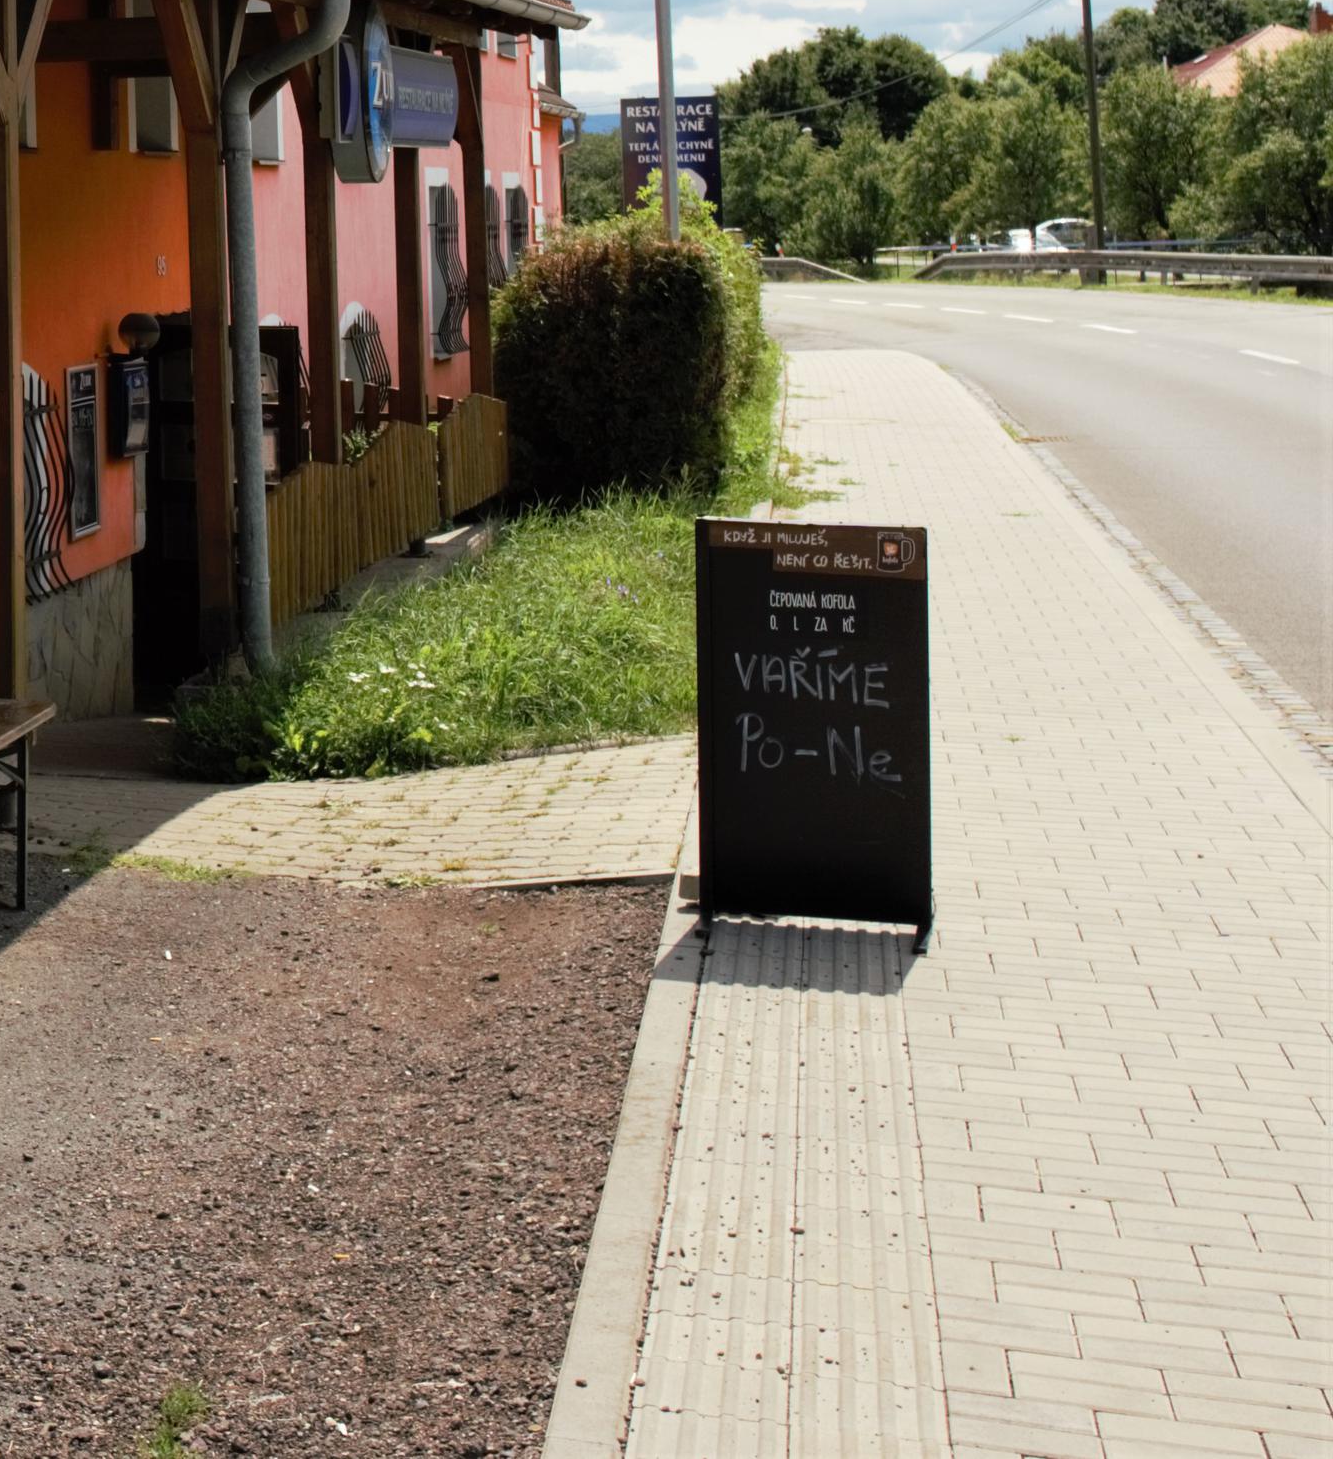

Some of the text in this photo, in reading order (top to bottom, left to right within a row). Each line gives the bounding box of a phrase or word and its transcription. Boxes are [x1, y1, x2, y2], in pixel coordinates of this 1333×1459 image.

[626, 103, 713, 118] RESTRACE
[635, 122, 655, 133] NA
[629, 140, 659, 151] TEPLÁ
[723, 527, 828, 547] KDYŽ JI MILUJEŠ,
[776, 553, 873, 570] NENÍ CO ŘEŠIT.
[769, 589, 856, 610] ČEPOVANÁ KOFOLA
[793, 615, 800, 631] L
[814, 616, 828, 632] ZA
[842, 615, 855, 633] KČ
[734, 646, 890, 709] VAŘÍME
